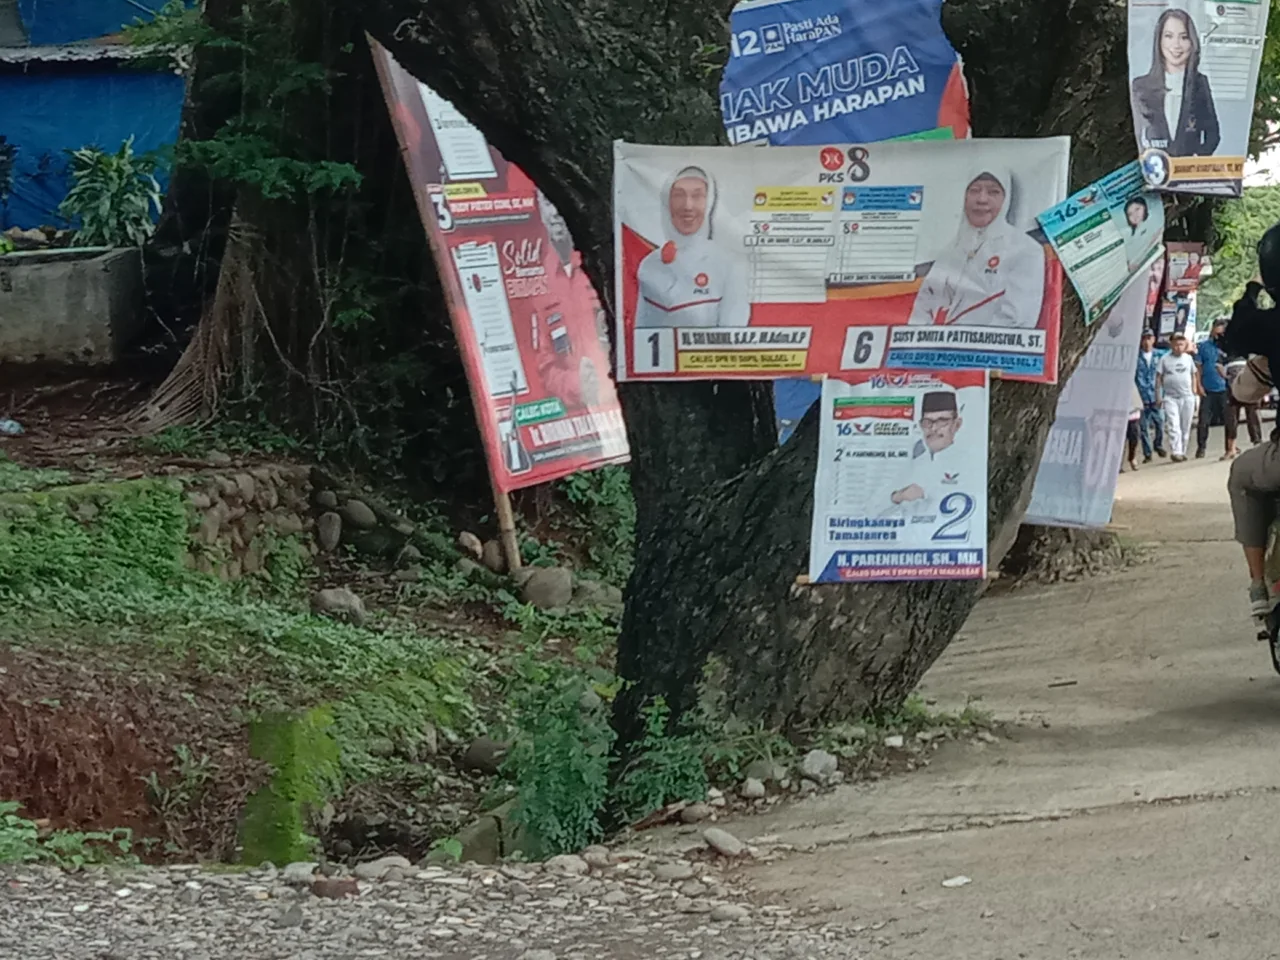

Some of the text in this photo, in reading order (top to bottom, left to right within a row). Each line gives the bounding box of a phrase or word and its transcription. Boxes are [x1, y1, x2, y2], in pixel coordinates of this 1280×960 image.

[782, 14, 840, 32] Pasti Ada
[784, 24, 842, 44] HaraPAN
[796, 46, 920, 104] MUDA
[813, 75, 926, 122] HARAPAN
[818, 172, 844, 183] PKS
[847, 147, 870, 182] 8
[1149, 155, 1165, 185] 3
[1054, 203, 1078, 222] 16
[647, 332, 660, 367] 1
[853, 331, 873, 364] 6
[836, 422, 852, 436] 16
[931, 492, 975, 541] 2
